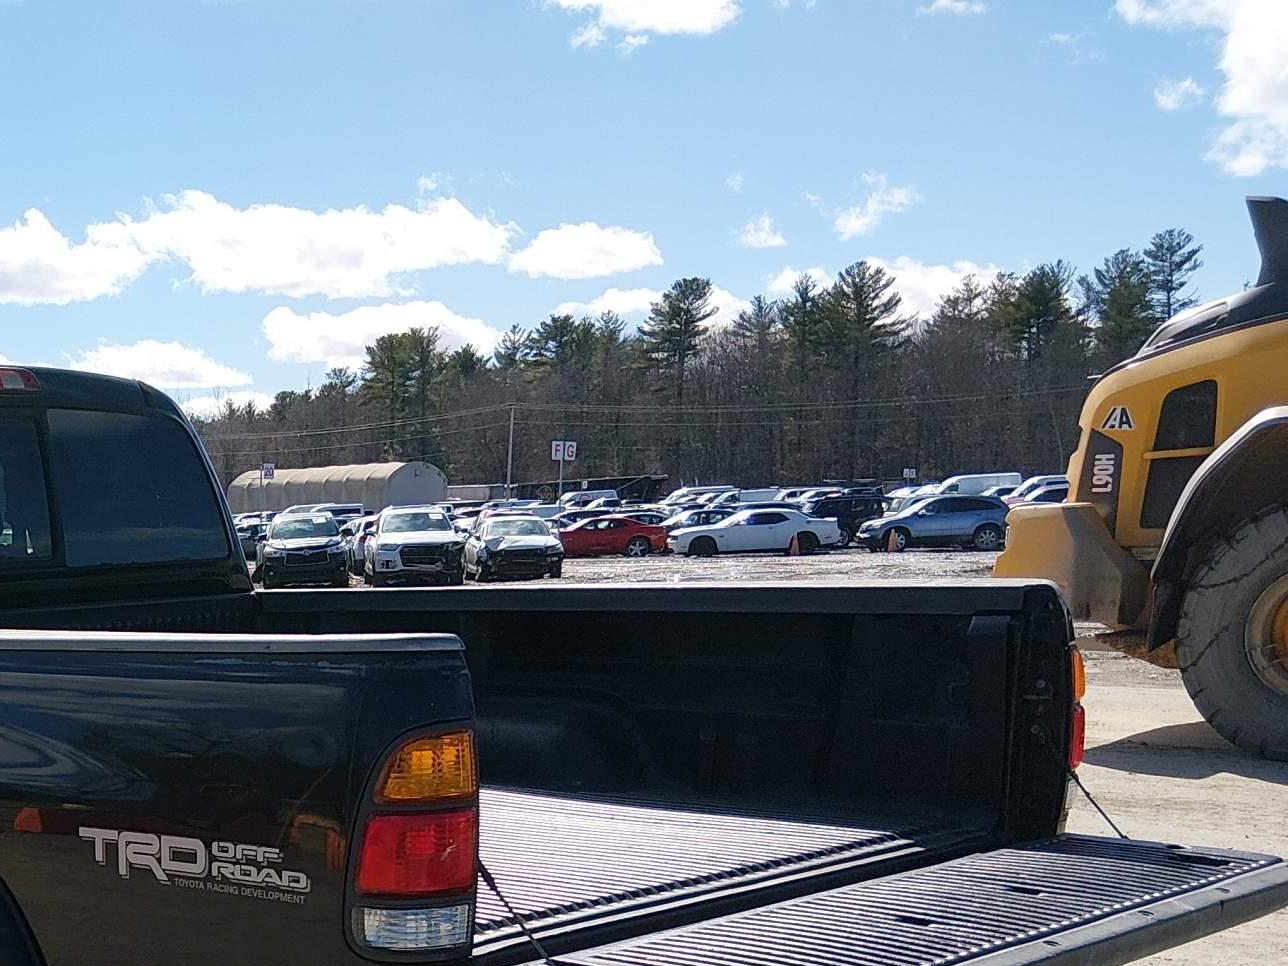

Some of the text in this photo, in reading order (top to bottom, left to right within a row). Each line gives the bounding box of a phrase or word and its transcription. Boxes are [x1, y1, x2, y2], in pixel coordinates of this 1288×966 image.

[554, 444, 561, 457] F
[567, 444, 575, 458] G
[1092, 454, 1115, 493] L90H
[78, 826, 209, 885] TRD
[212, 841, 284, 865] OFF
[212, 861, 311, 893] ROAD
[175, 878, 306, 904] TOYOTA RACING DEVELOPMENT
